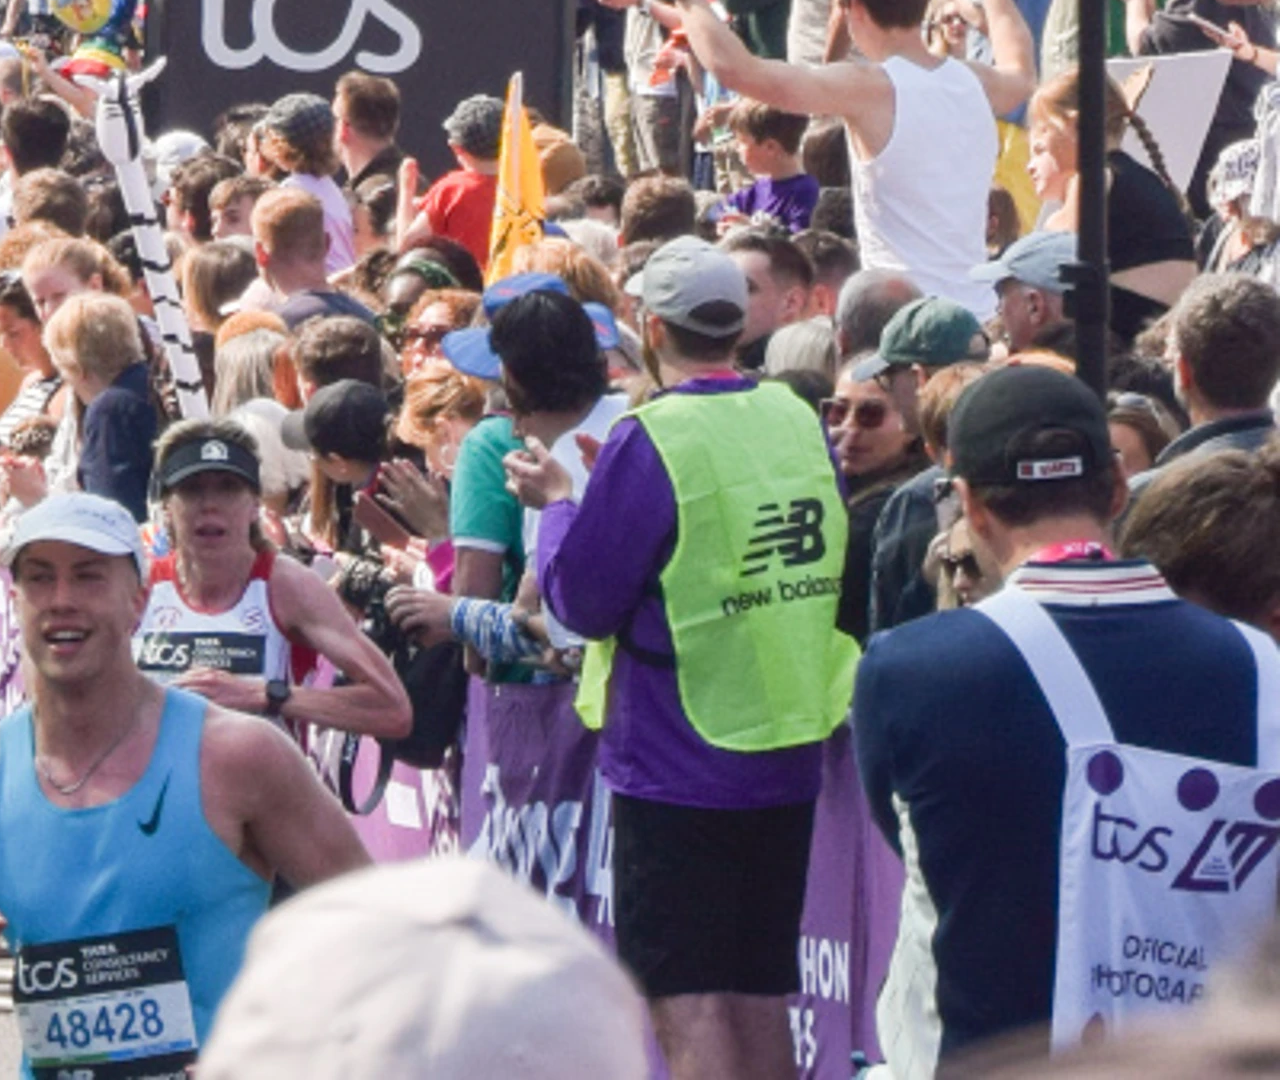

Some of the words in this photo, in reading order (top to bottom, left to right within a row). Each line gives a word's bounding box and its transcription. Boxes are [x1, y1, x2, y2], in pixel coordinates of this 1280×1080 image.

[721, 585, 774, 618] new
[17, 956, 79, 995] tcs
[45, 998, 165, 1049] 48428
